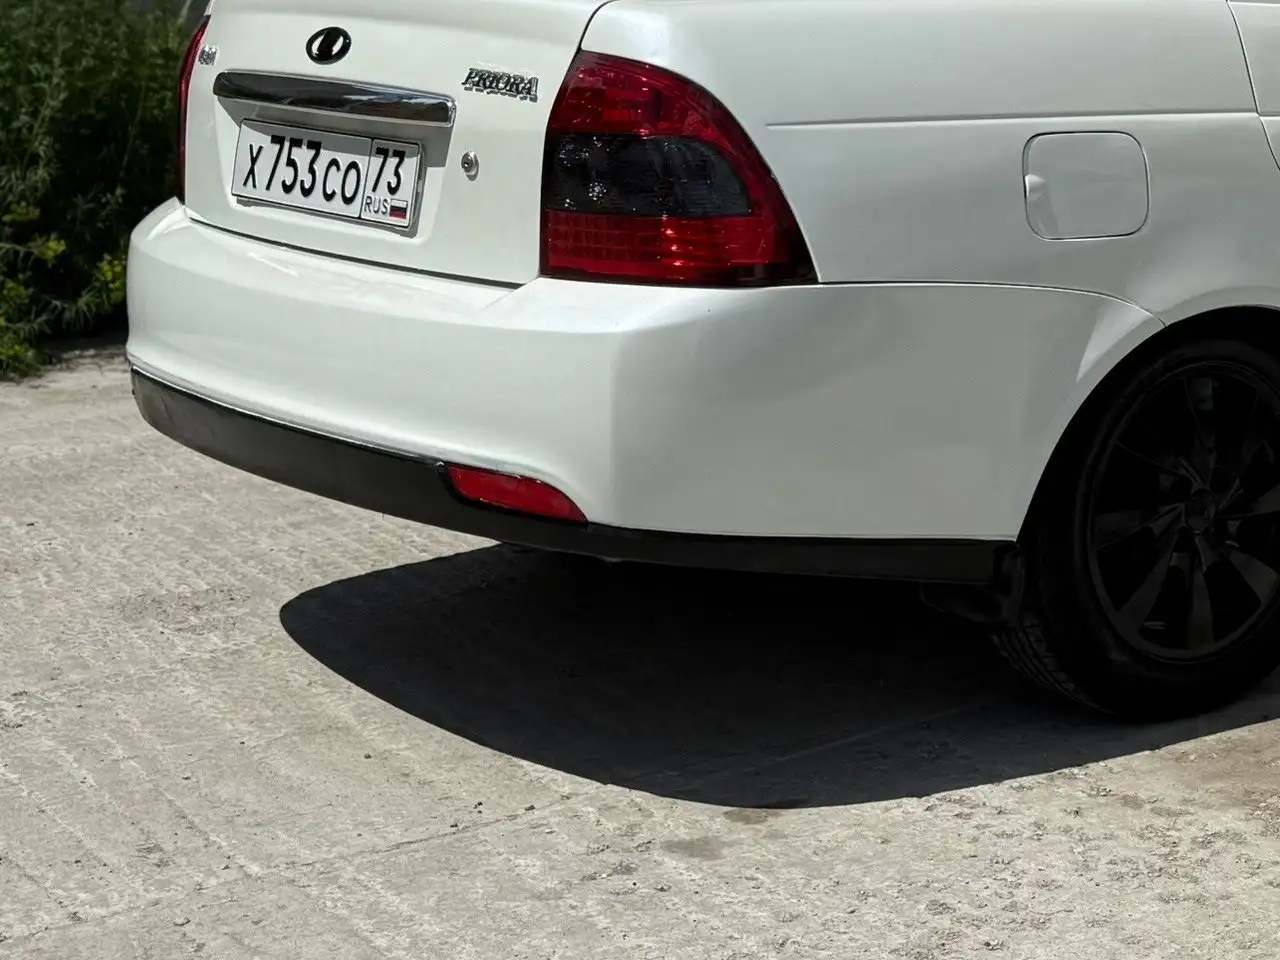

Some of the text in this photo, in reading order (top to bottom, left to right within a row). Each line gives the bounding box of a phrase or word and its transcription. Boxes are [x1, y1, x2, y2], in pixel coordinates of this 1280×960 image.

[461, 66, 539, 100] PRIORA
[371, 147, 406, 195] 73
[364, 195, 389, 214] RUS
